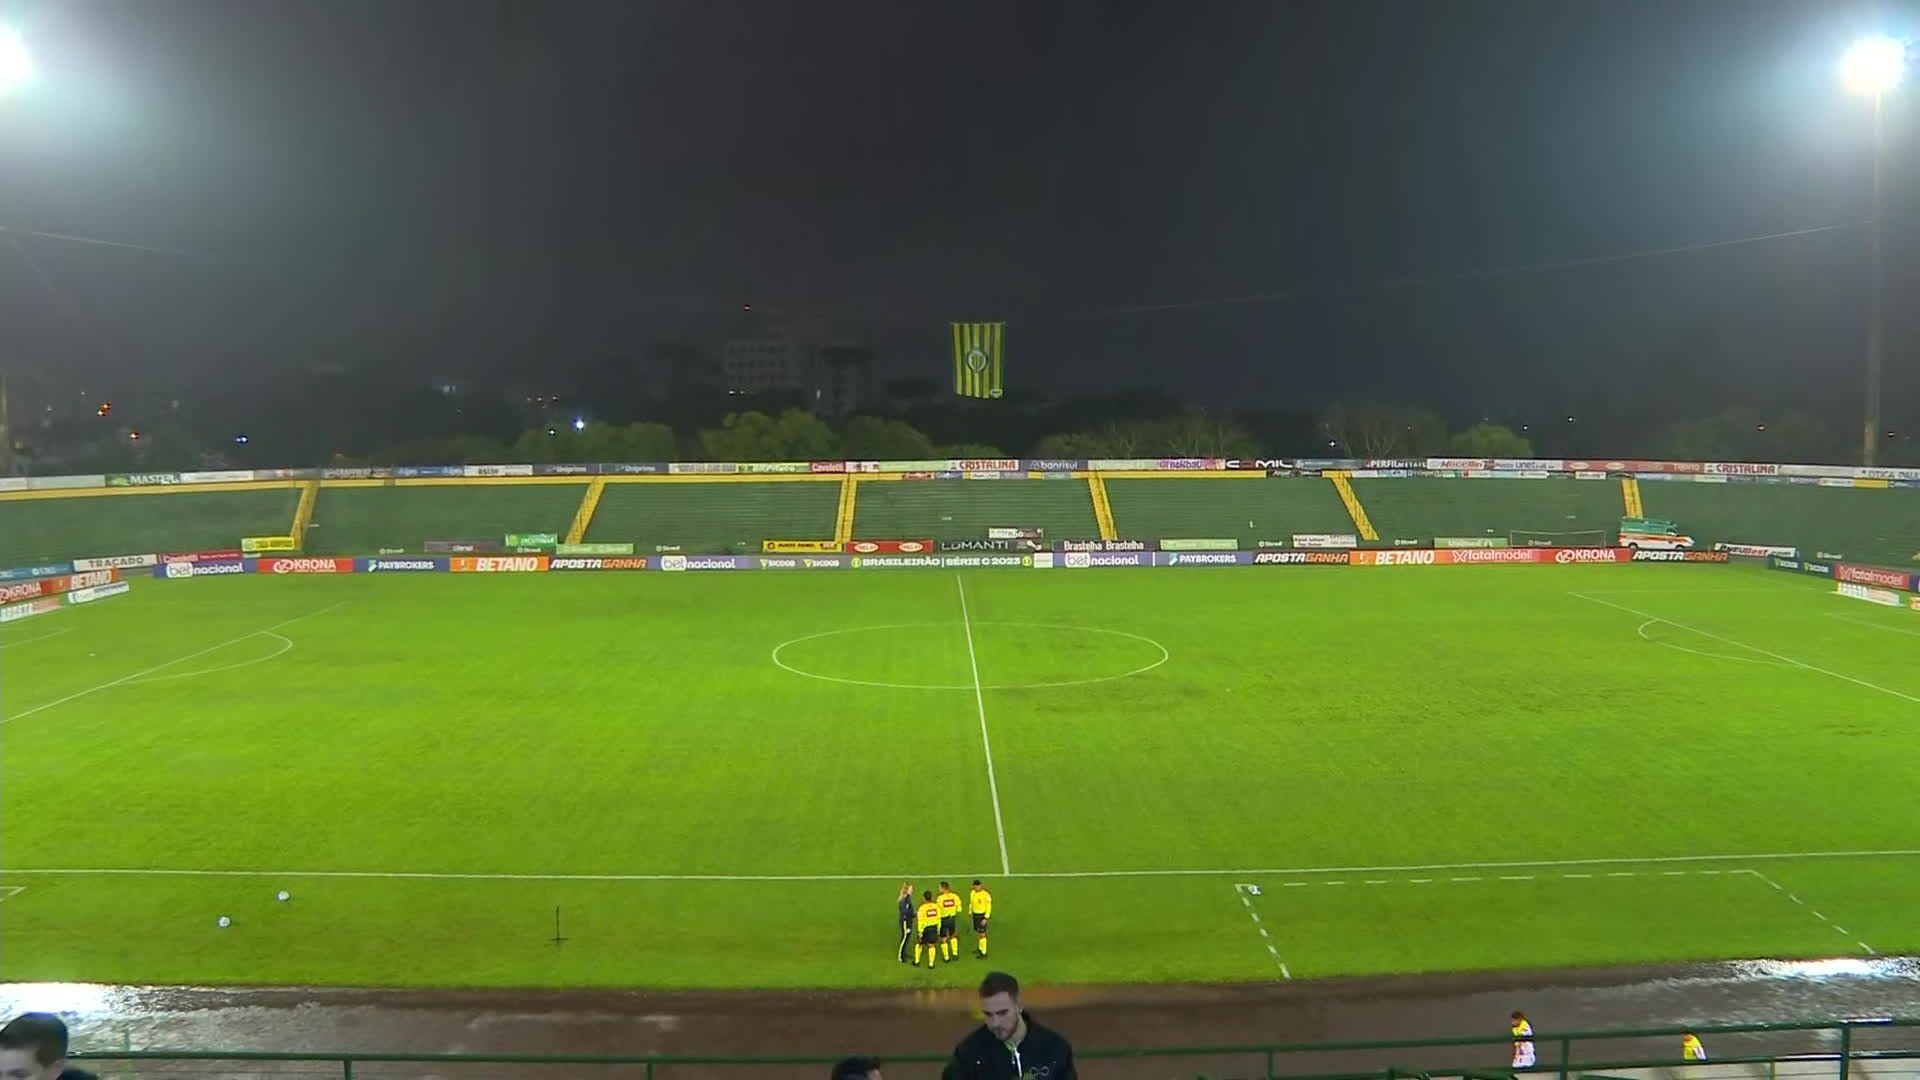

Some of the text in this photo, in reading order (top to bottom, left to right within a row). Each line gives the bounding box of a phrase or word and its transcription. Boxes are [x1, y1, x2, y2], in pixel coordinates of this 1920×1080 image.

[960, 460, 1016, 470] CRISTALINA
[1040, 461, 1077, 469] banrisul
[1716, 464, 1775, 474] CRISTALINA
[130, 473, 178, 485] MASTER
[1064, 541, 1144, 550] Brastelha Brastelha
[1180, 554, 1236, 563] PAYBROKERS
[1255, 553, 1348, 563] APOSTAGANHA
[1375, 551, 1434, 564] BETANO
[1468, 550, 1530, 560] fatalmodel
[1575, 549, 1615, 560] KRONA
[1633, 551, 1728, 561] APOSTAGANHA
[293, 559, 336, 570] KRONA
[378, 560, 434, 570] PAYBROKERS
[476, 557, 538, 571] BETANO
[550, 559, 647, 569] APOSTAGANHA
[863, 555, 1020, 566] BRASILEIRÃO SÉRIE C 2023
[71, 570, 112, 590] BETANO
[1852, 568, 1903, 585] fatalmodel
[8, 581, 42, 599] KRONA
